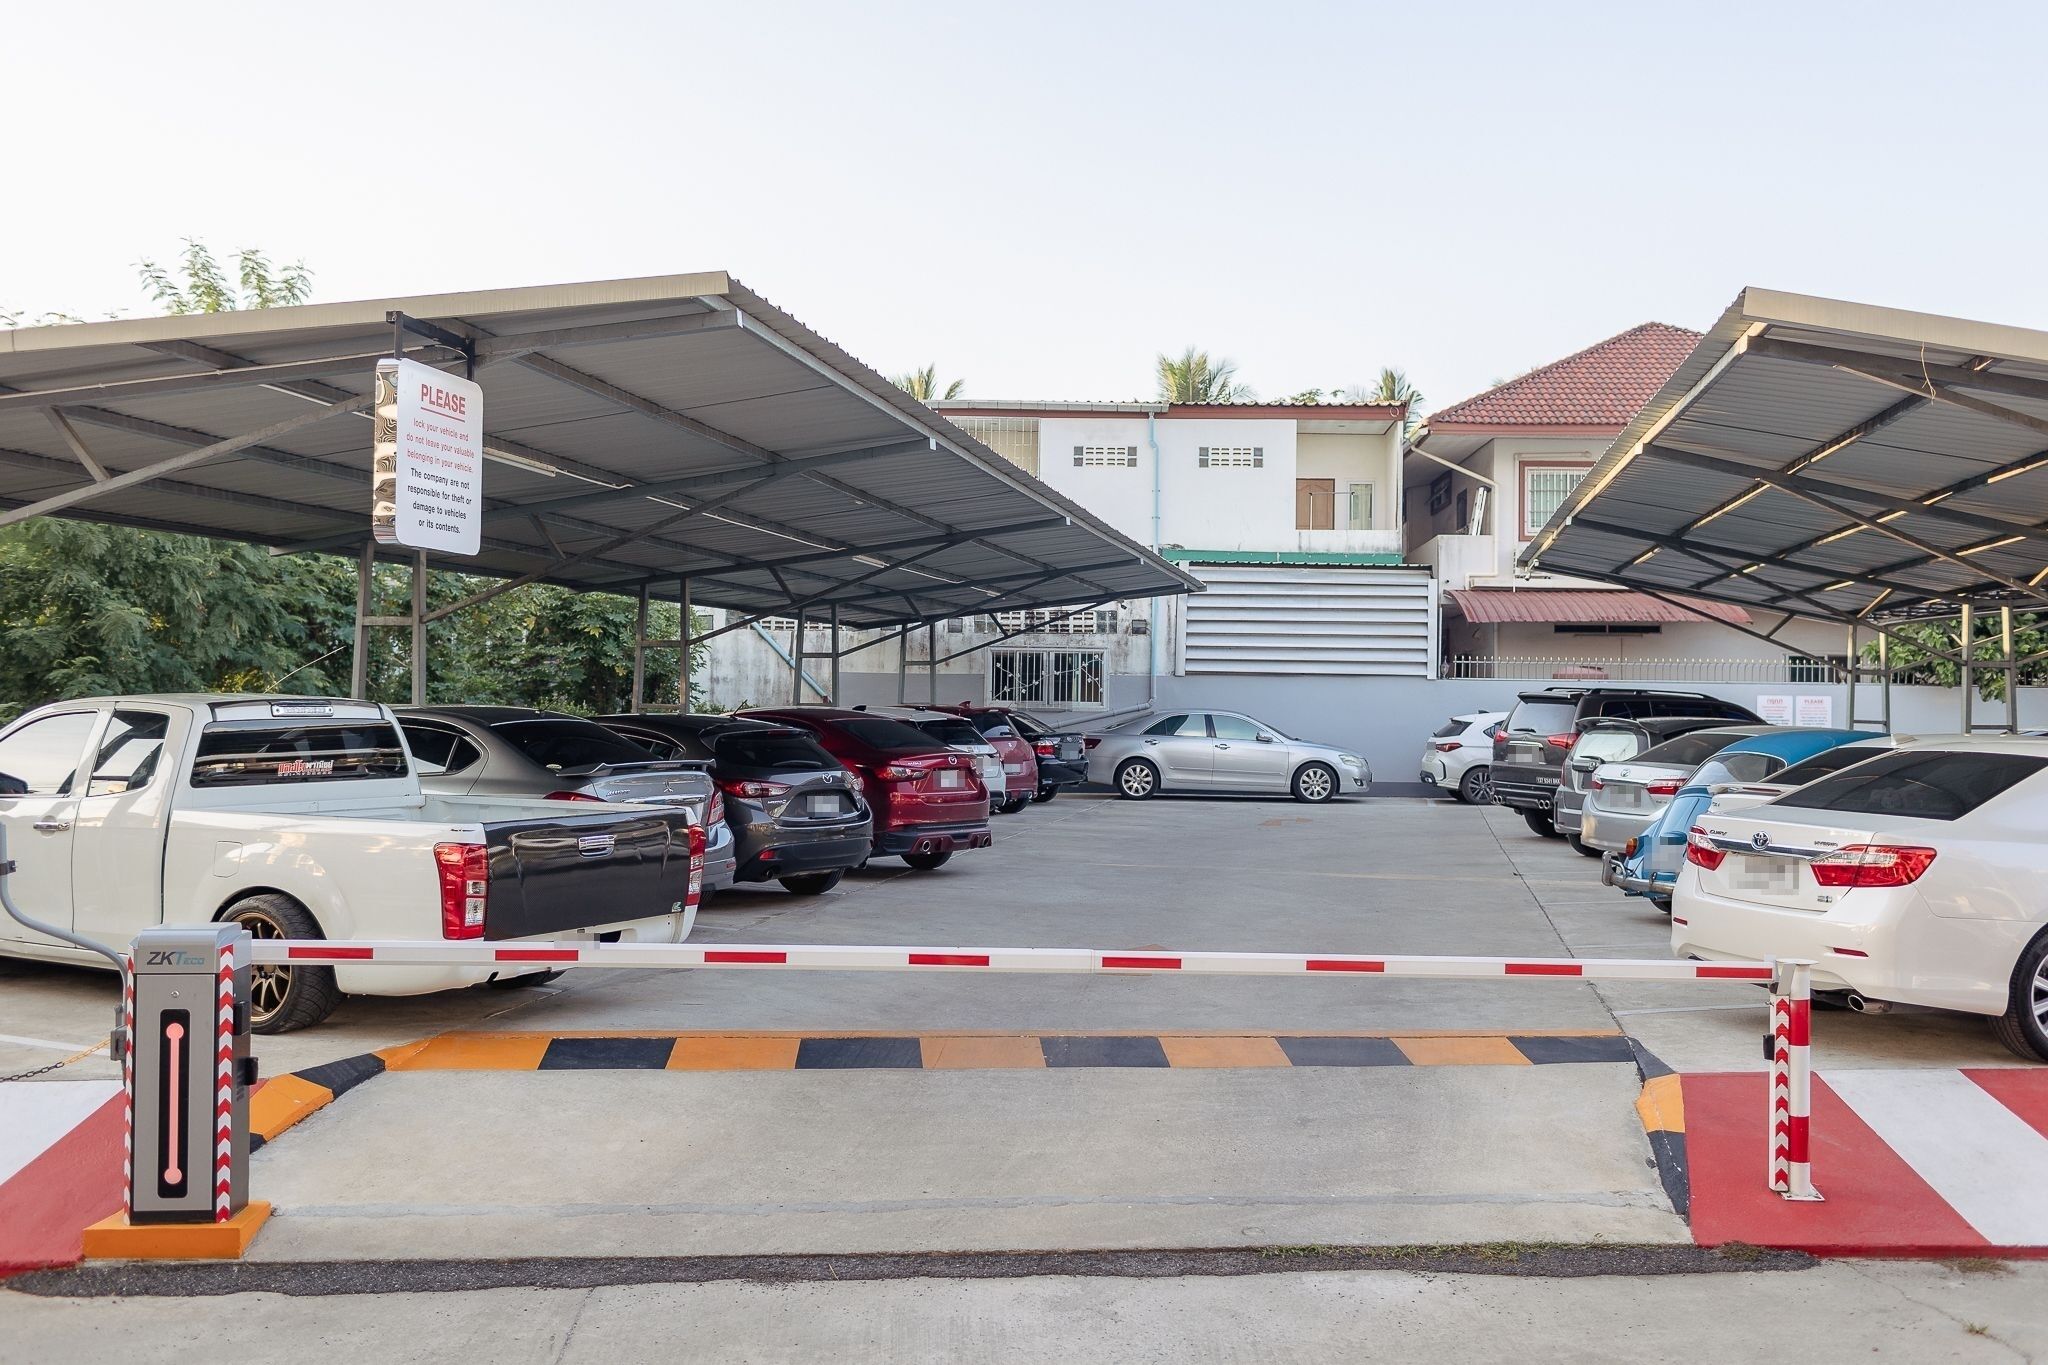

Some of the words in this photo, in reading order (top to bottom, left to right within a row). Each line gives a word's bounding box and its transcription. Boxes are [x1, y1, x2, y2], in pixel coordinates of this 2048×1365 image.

[422, 384, 466, 415] PLEASE
[414, 418, 425, 429] lock
[426, 423, 438, 432] your
[440, 427, 458, 439] vehicle
[459, 433, 469, 441] and
[407, 432, 414, 441] do
[415, 436, 424, 445] not
[426, 437, 440, 449] leave
[441, 443, 452, 452] your
[407, 448, 433, 464] belonging
[435, 456, 440, 464] in
[441, 459, 452, 467] your
[411, 468, 421, 478] The
[424, 473, 449, 486] company
[450, 479, 459, 487] are
[460, 481, 470, 490] not
[407, 485, 440, 499] responsible
[442, 491, 450, 500] for
[452, 494, 465, 504] theft
[413, 501, 435, 514] damage
[437, 506, 443, 515] to
[444, 509, 466, 519] vehicles
[419, 519, 425, 527] or
[426, 519, 434, 529] its
[435, 522, 460, 534] contents.
